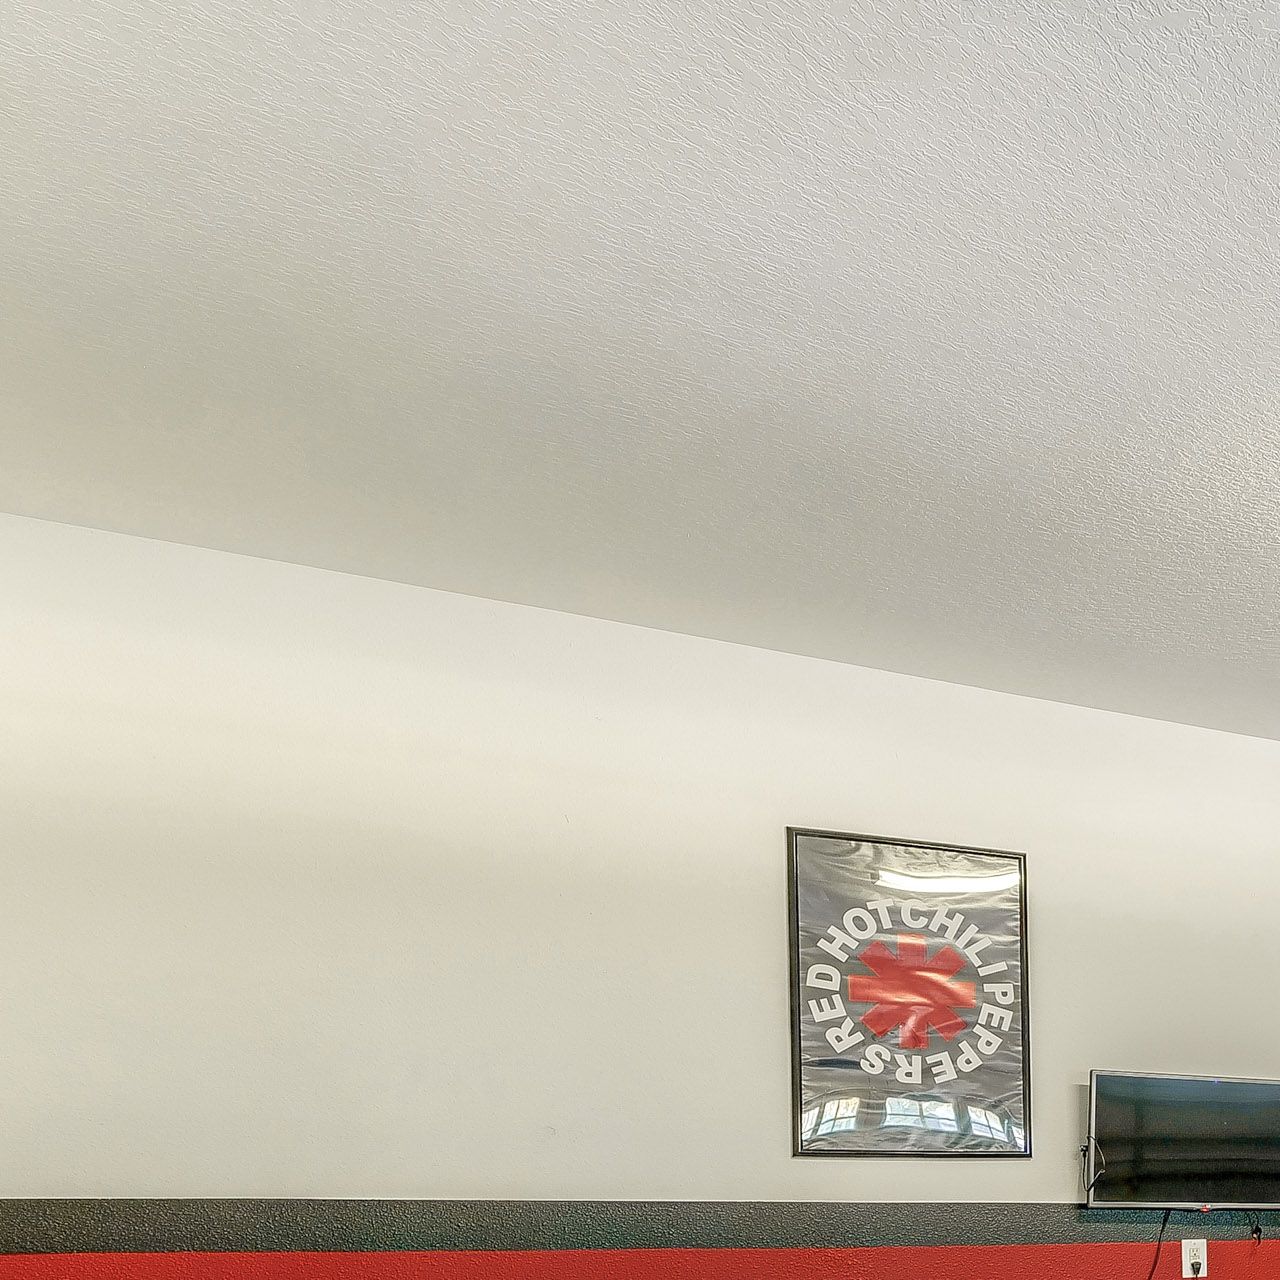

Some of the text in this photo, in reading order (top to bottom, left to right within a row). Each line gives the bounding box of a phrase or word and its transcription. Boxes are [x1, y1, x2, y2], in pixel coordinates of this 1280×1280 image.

[806, 898, 1015, 1085] RED HOT CHILI PEPPERS
